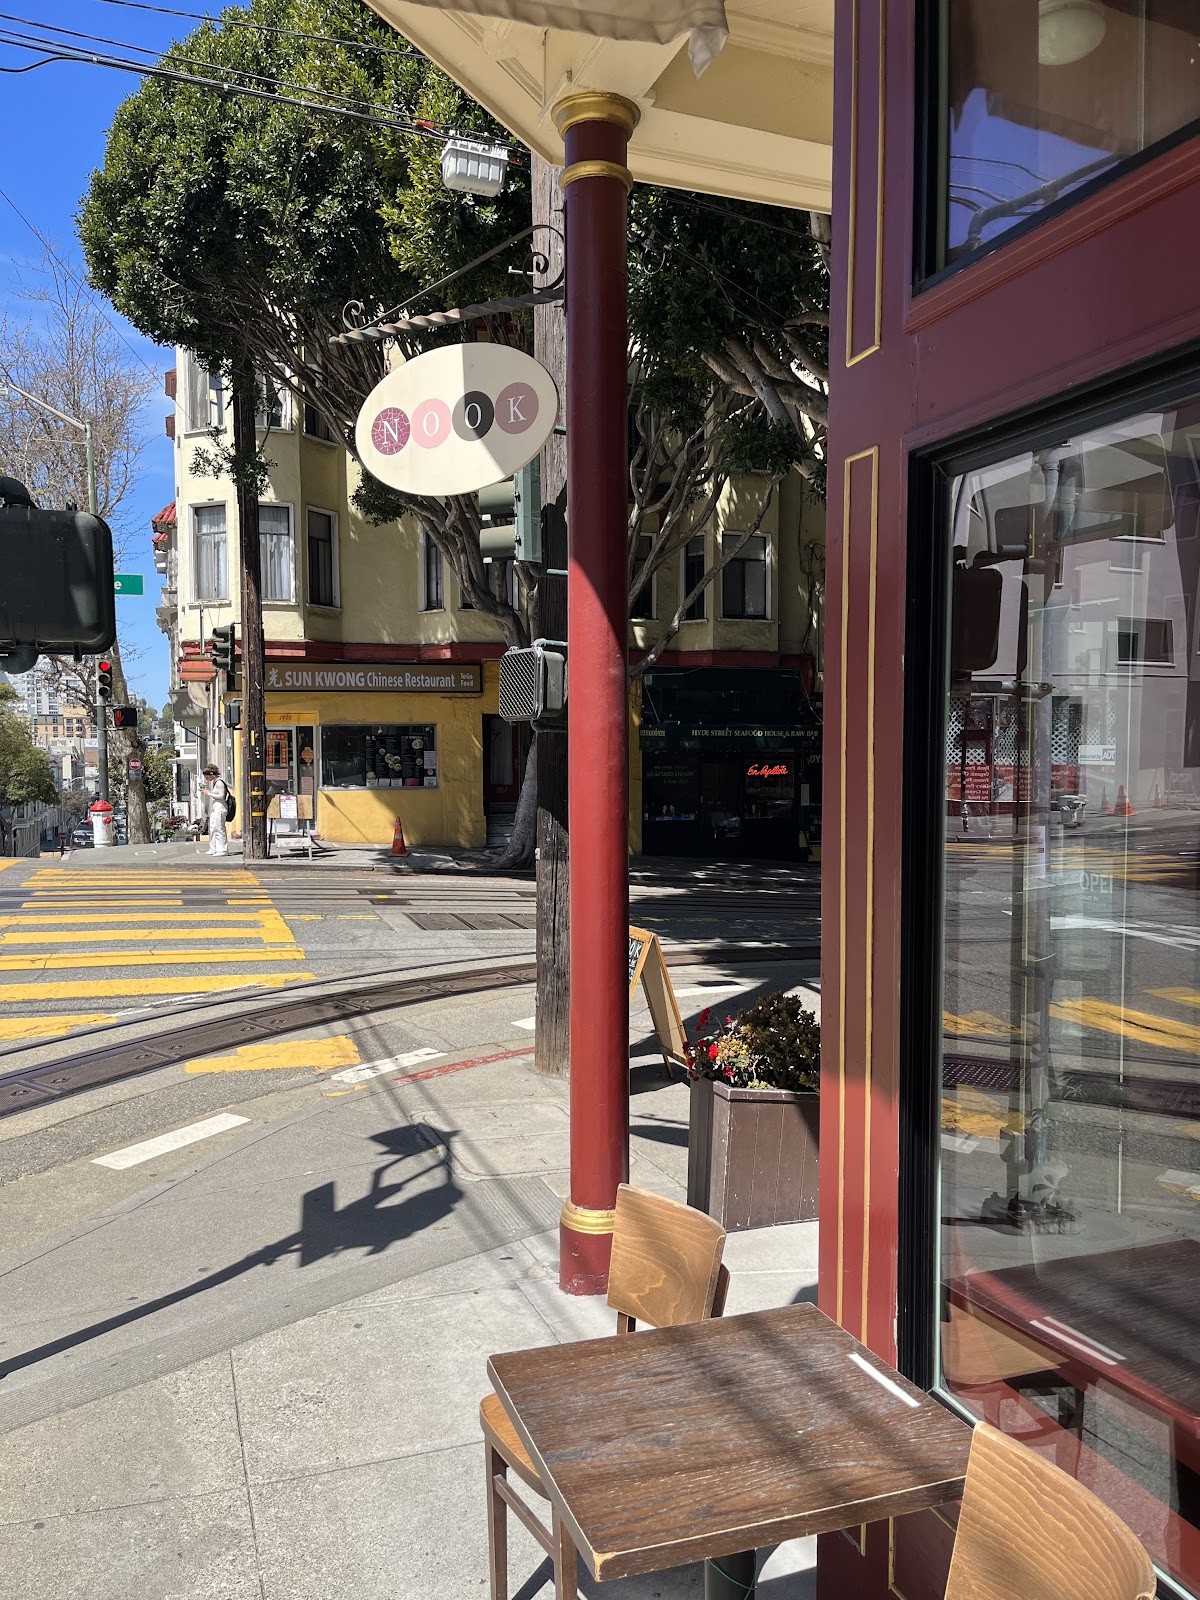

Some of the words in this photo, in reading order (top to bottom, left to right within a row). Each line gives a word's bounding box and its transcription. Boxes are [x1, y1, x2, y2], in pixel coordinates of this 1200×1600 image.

[382, 395, 528, 446] NOOK
[285, 671, 312, 687] SUN
[315, 671, 365, 687] KWONG
[367, 671, 403, 688] Chinese
[404, 672, 456, 688] Restaurant
[460, 679, 474, 687] Food
[734, 729, 763, 737] SEAFOOD
